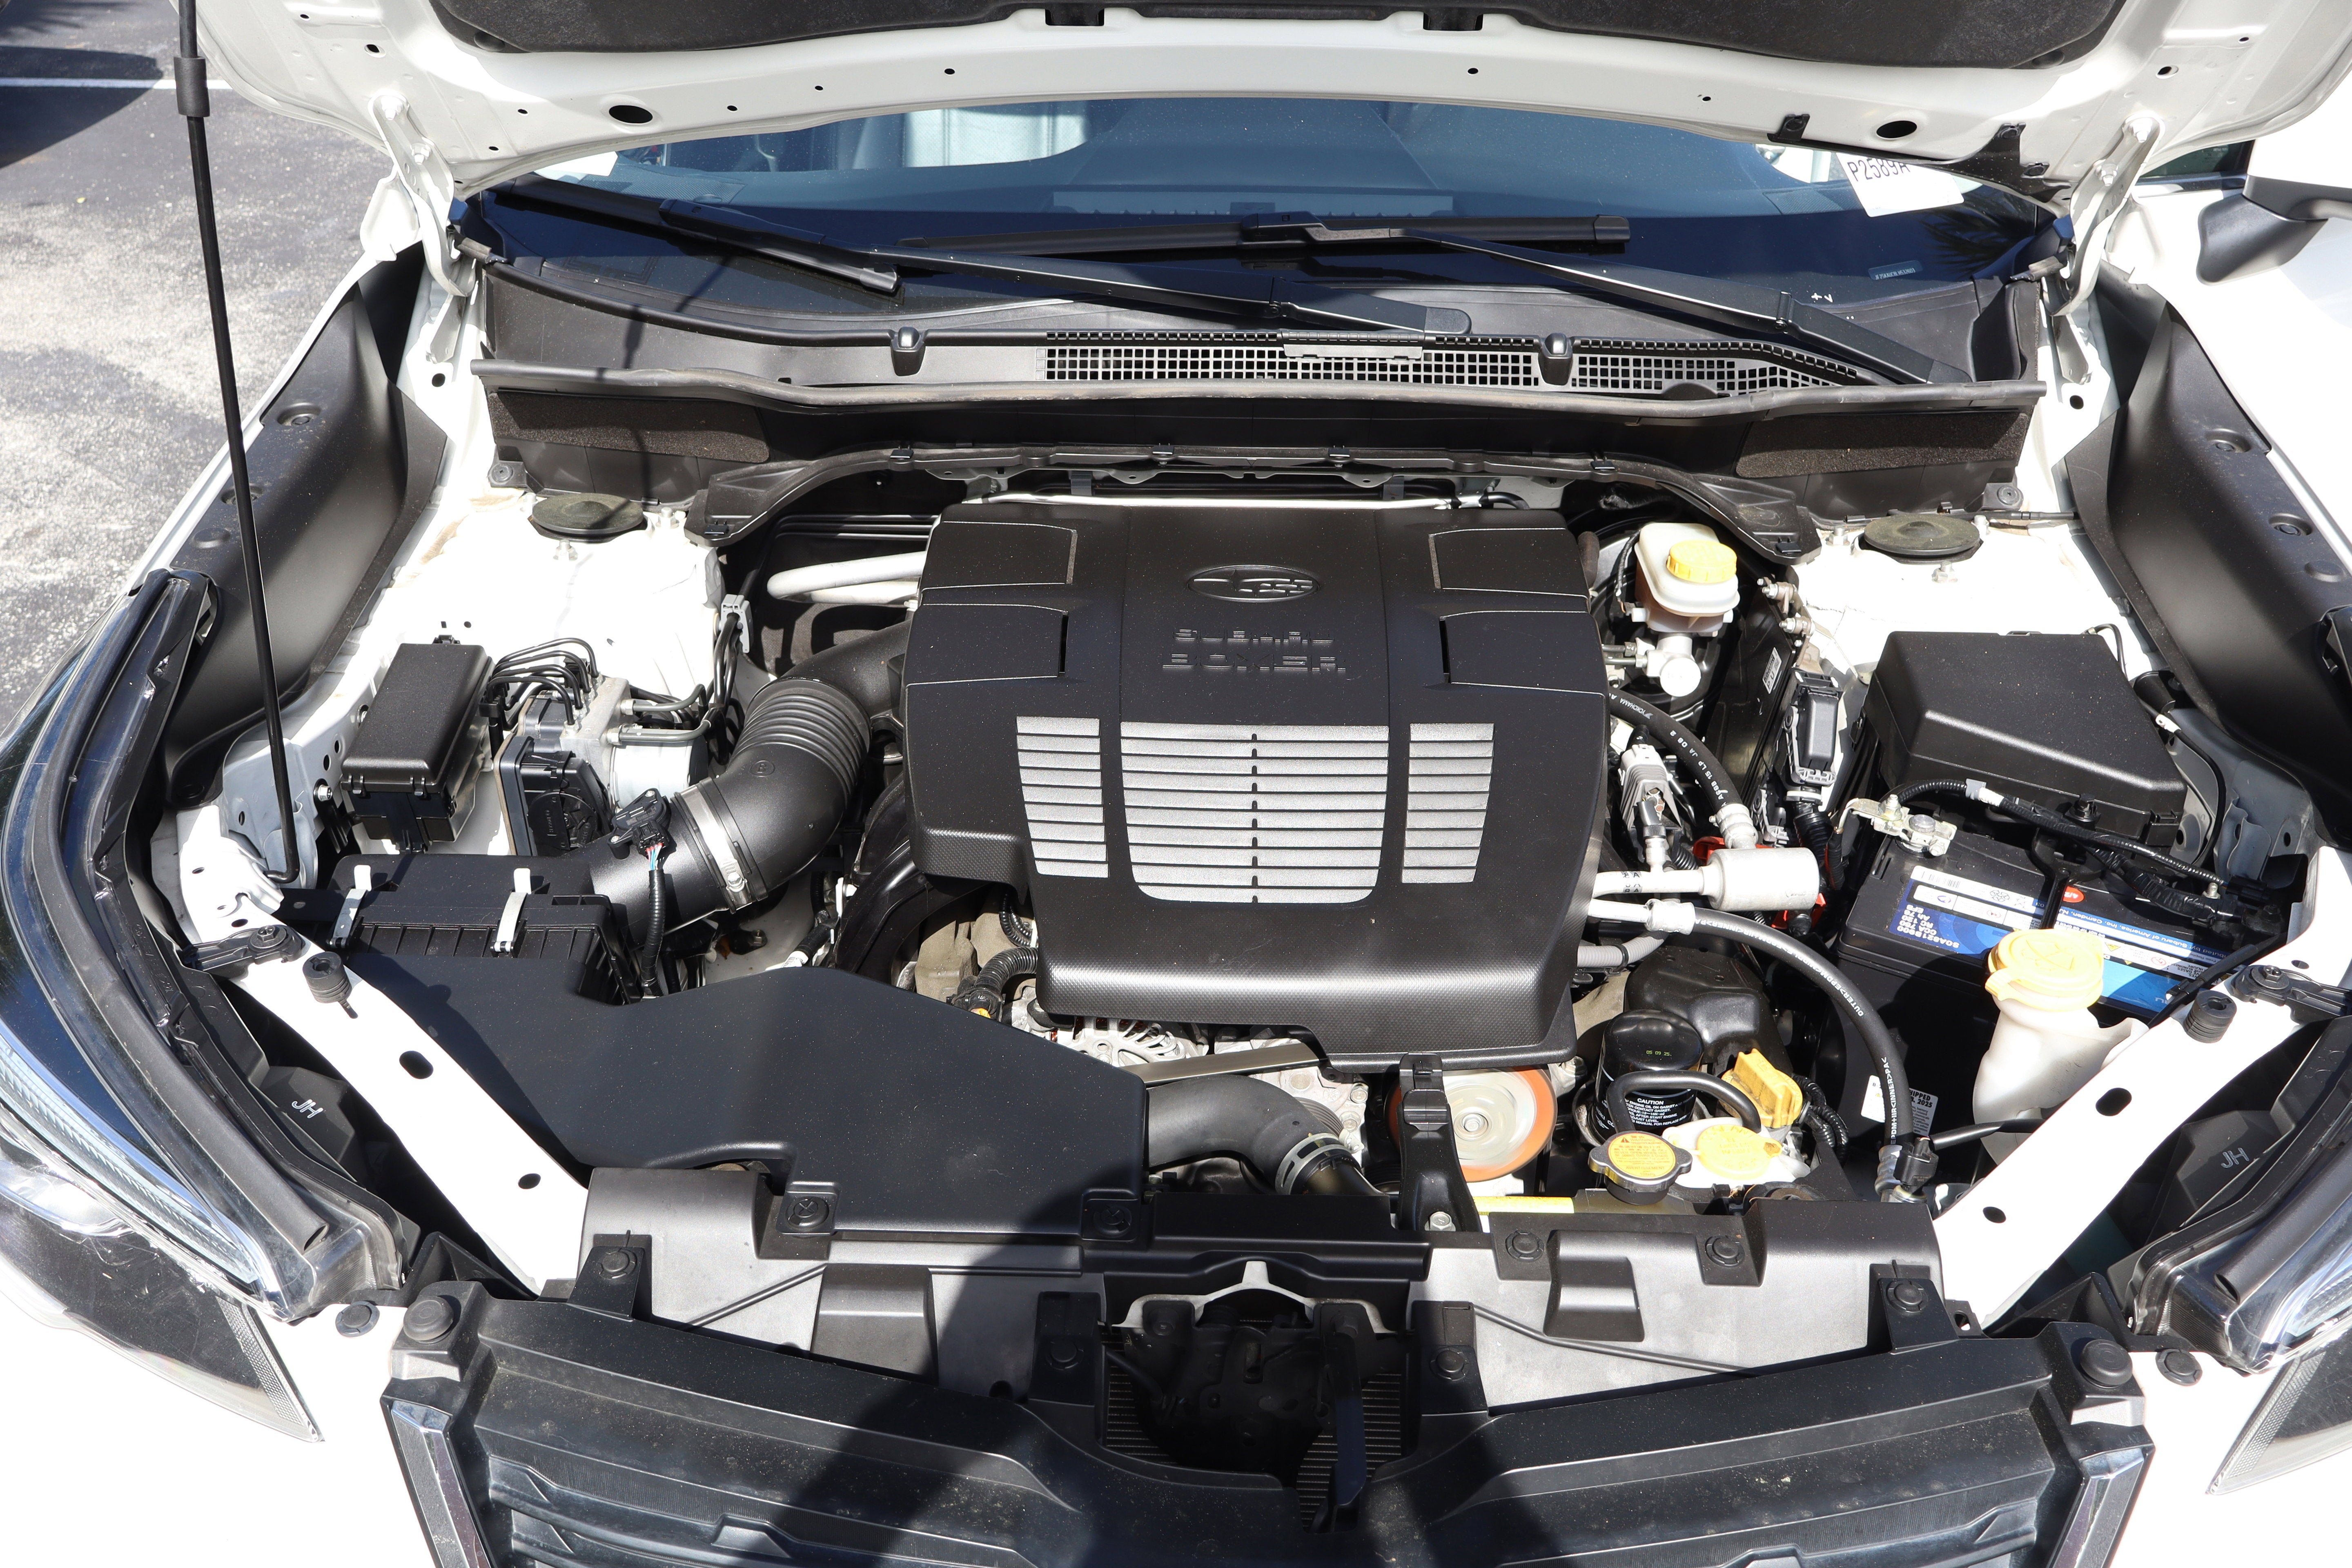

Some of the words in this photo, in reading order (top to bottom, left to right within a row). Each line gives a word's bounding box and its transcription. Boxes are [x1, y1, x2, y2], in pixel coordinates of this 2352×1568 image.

[1172, 629, 1335, 643] SUBARU
[1162, 654, 1346, 671] BOXER
[1619, 697, 1646, 715] YOKOHAMA
[2070, 911, 2103, 924] Camden,
[1918, 925, 1937, 935] CCA
[2118, 924, 2151, 938] America,
[2160, 936, 2188, 949] Subaru
[292, 1098, 323, 1118] JH
[1917, 1099, 1933, 1108] 2025
[2220, 1147, 2250, 1169] JH
